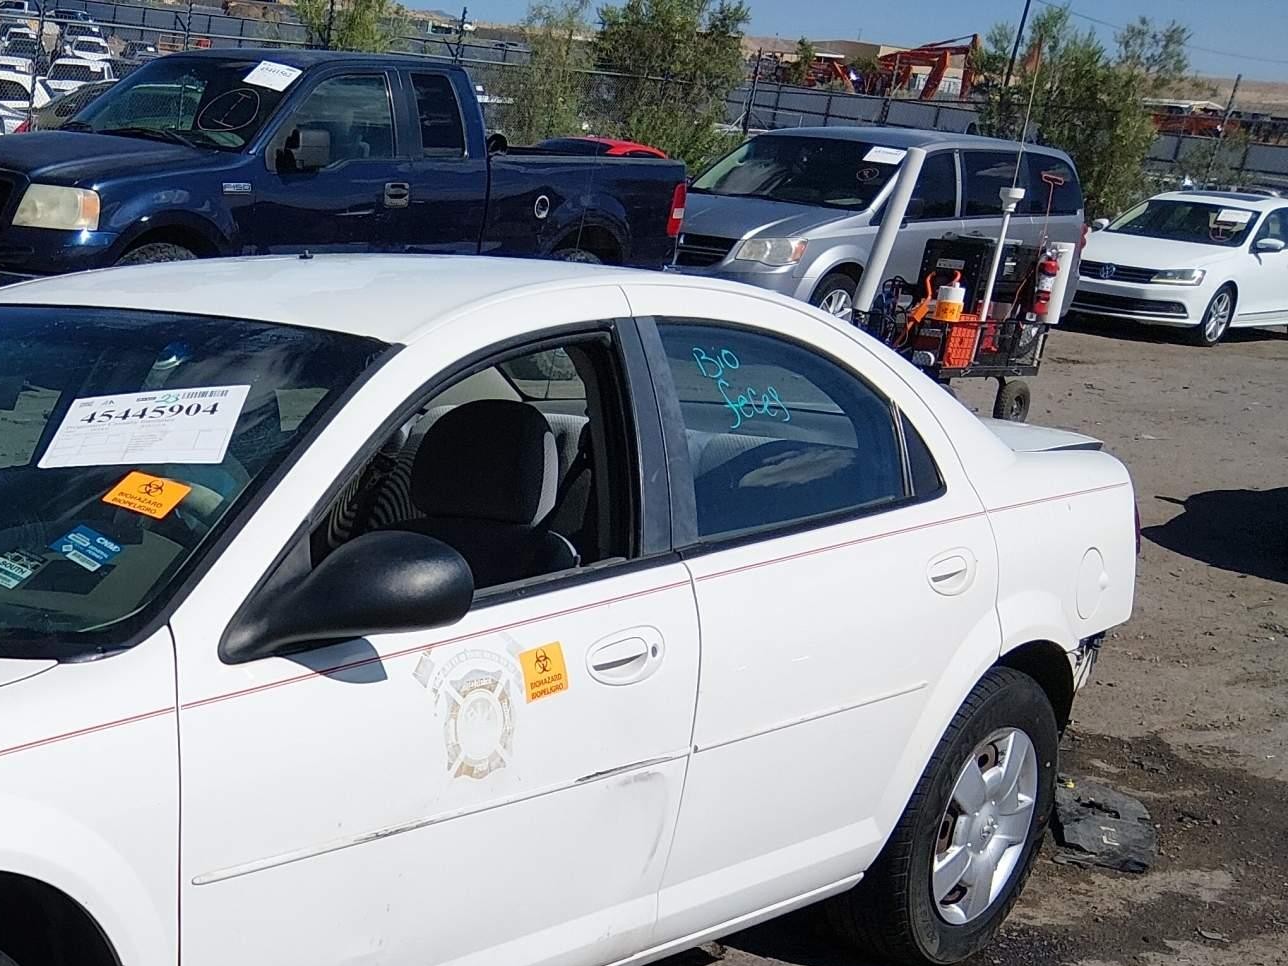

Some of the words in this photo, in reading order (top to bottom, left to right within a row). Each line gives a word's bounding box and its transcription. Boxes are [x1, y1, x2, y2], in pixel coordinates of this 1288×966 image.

[80, 402, 219, 424] 45445904
[111, 497, 158, 515] BIOPELIGRO
[117, 491, 164, 509] BIOHAZARD
[0, 560, 28, 576] SOUTH
[529, 673, 562, 690] BIOHAZARD
[530, 682, 564, 700] BIOPELIGRO
